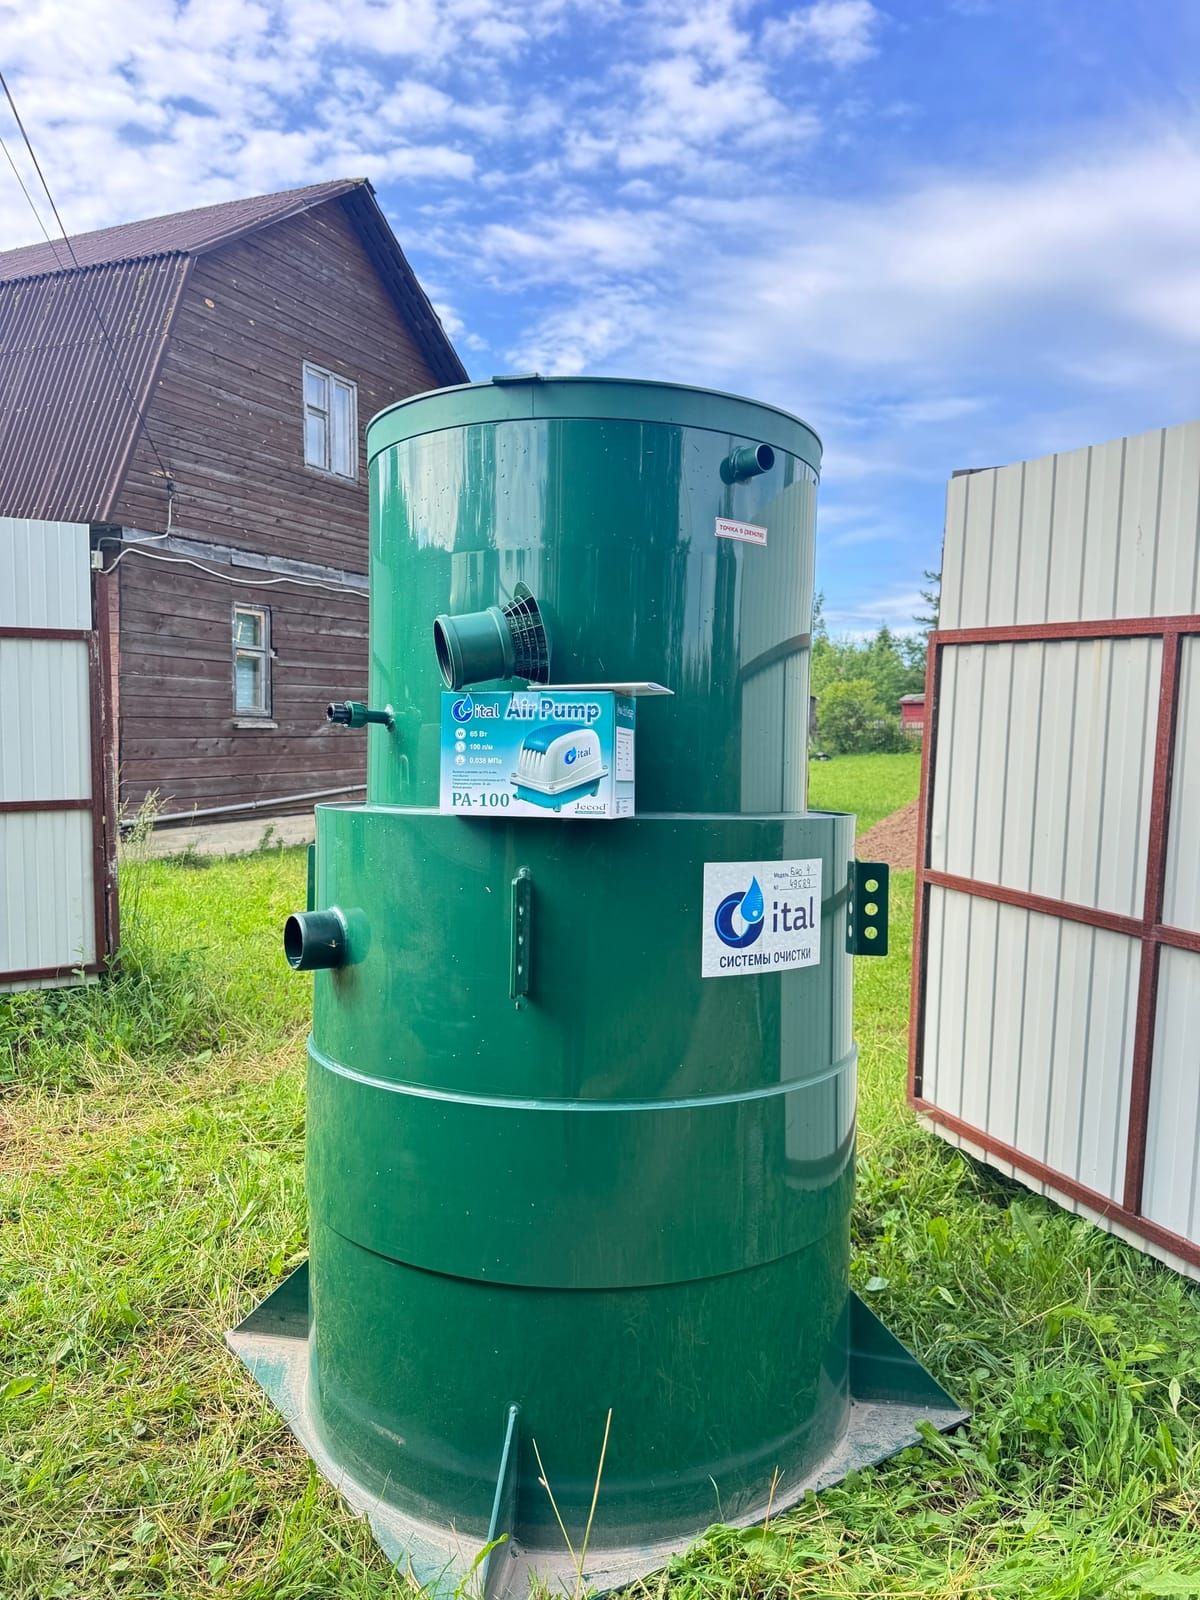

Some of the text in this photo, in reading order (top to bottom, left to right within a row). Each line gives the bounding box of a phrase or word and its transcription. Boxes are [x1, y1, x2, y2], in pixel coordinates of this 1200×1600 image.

[474, 703, 499, 718] ital
[506, 699, 538, 719] Air
[541, 699, 600, 724] Pump
[469, 743, 481, 751] 100
[577, 746, 591, 759] ital
[452, 792, 510, 808] PA-100
[772, 895, 815, 933] ital
[719, 947, 812, 969] СИСТЕМЫ ОЧИСТКИ
